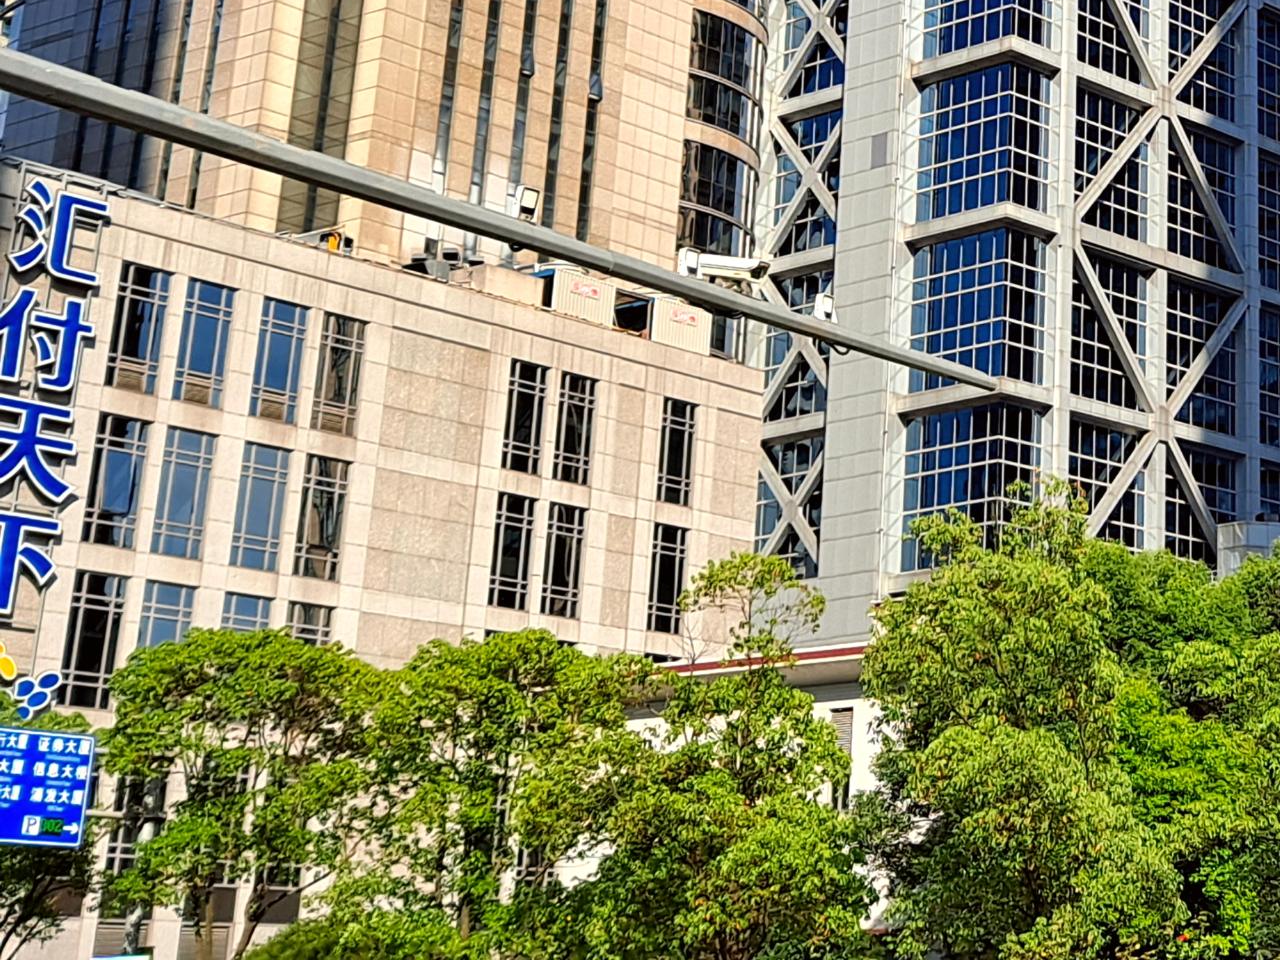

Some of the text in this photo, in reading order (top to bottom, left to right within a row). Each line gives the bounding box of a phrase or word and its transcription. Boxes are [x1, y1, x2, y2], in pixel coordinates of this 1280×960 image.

[0, 177, 109, 614] 汇付天下
[38, 737, 91, 755] 证券大厦
[33, 762, 88, 780] 信息大楼
[30, 787, 84, 805] 浦发大厦
